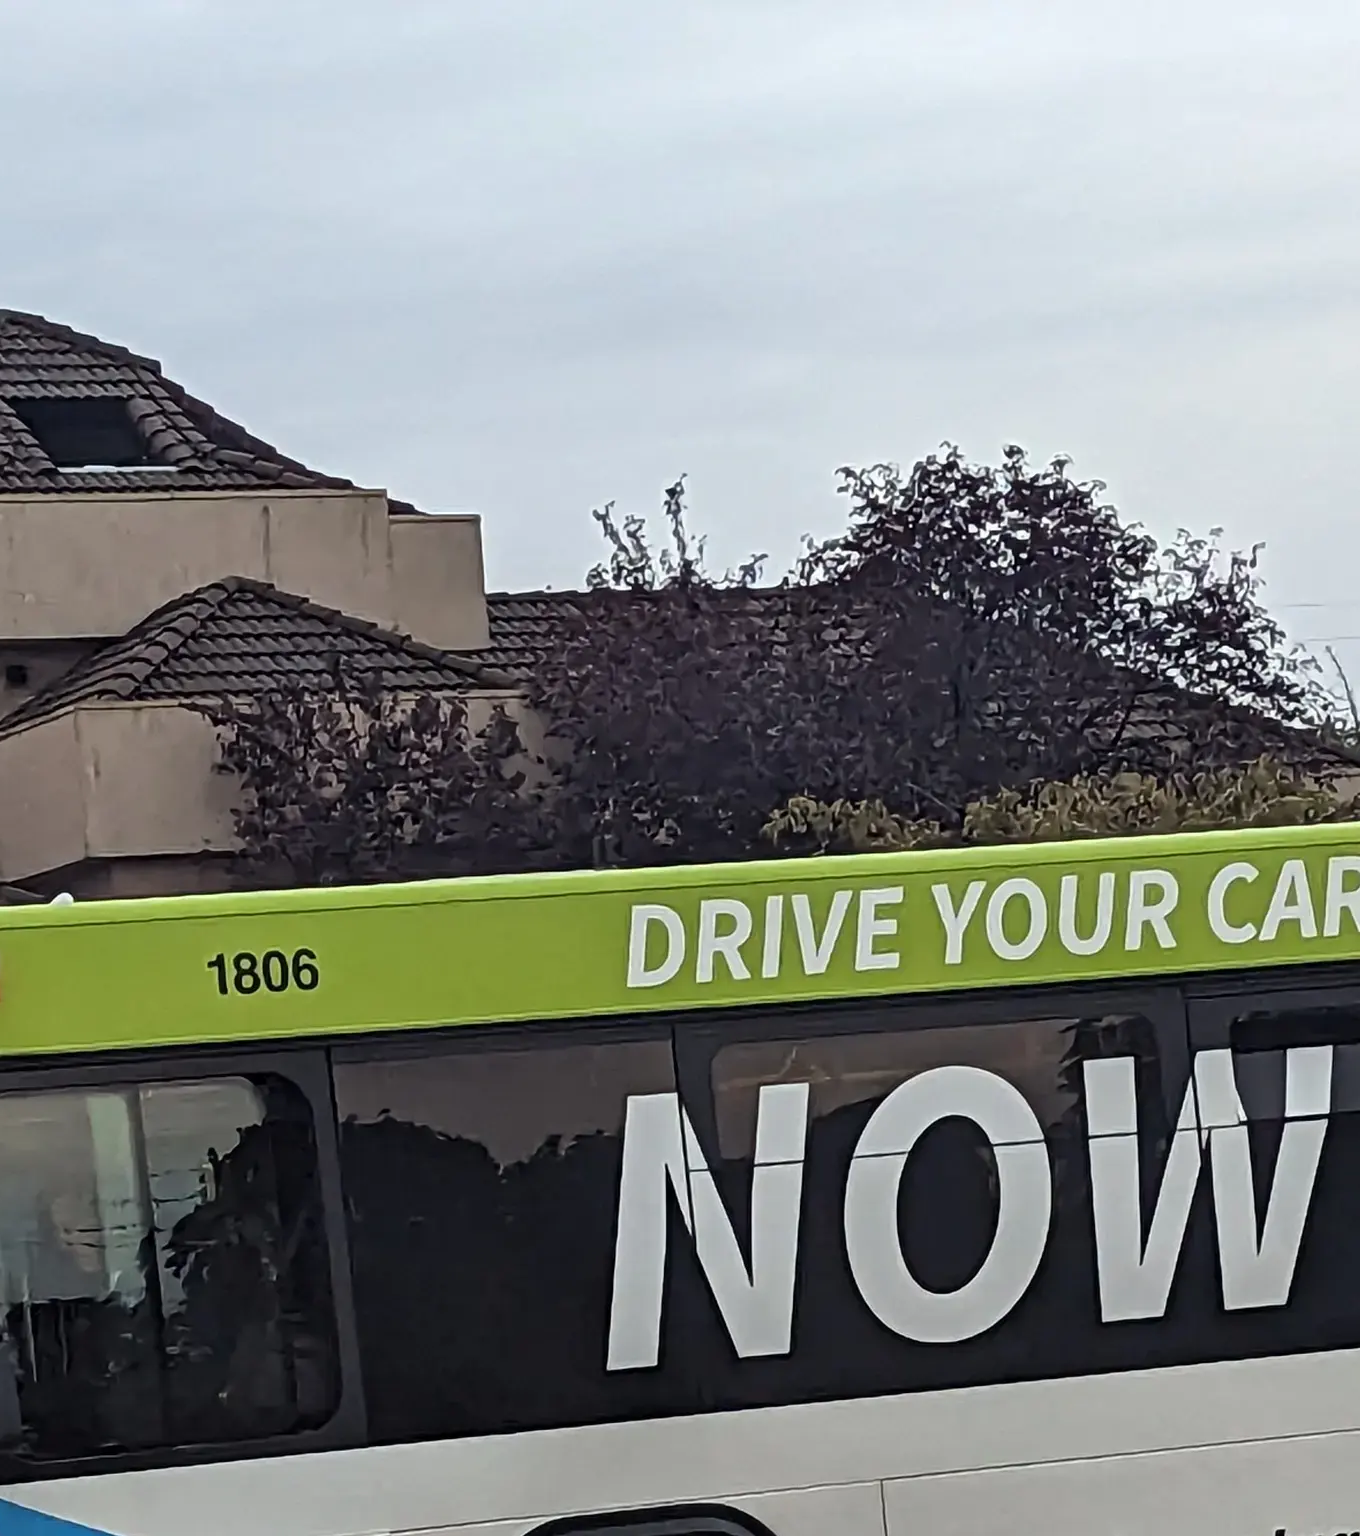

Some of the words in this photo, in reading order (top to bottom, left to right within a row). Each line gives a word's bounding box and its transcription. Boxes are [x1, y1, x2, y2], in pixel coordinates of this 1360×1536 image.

[207, 947, 320, 996] 1806
[626, 886, 904, 989] DRIVE
[931, 868, 1180, 966] YOUR
[605, 1044, 1335, 1372] NOW
